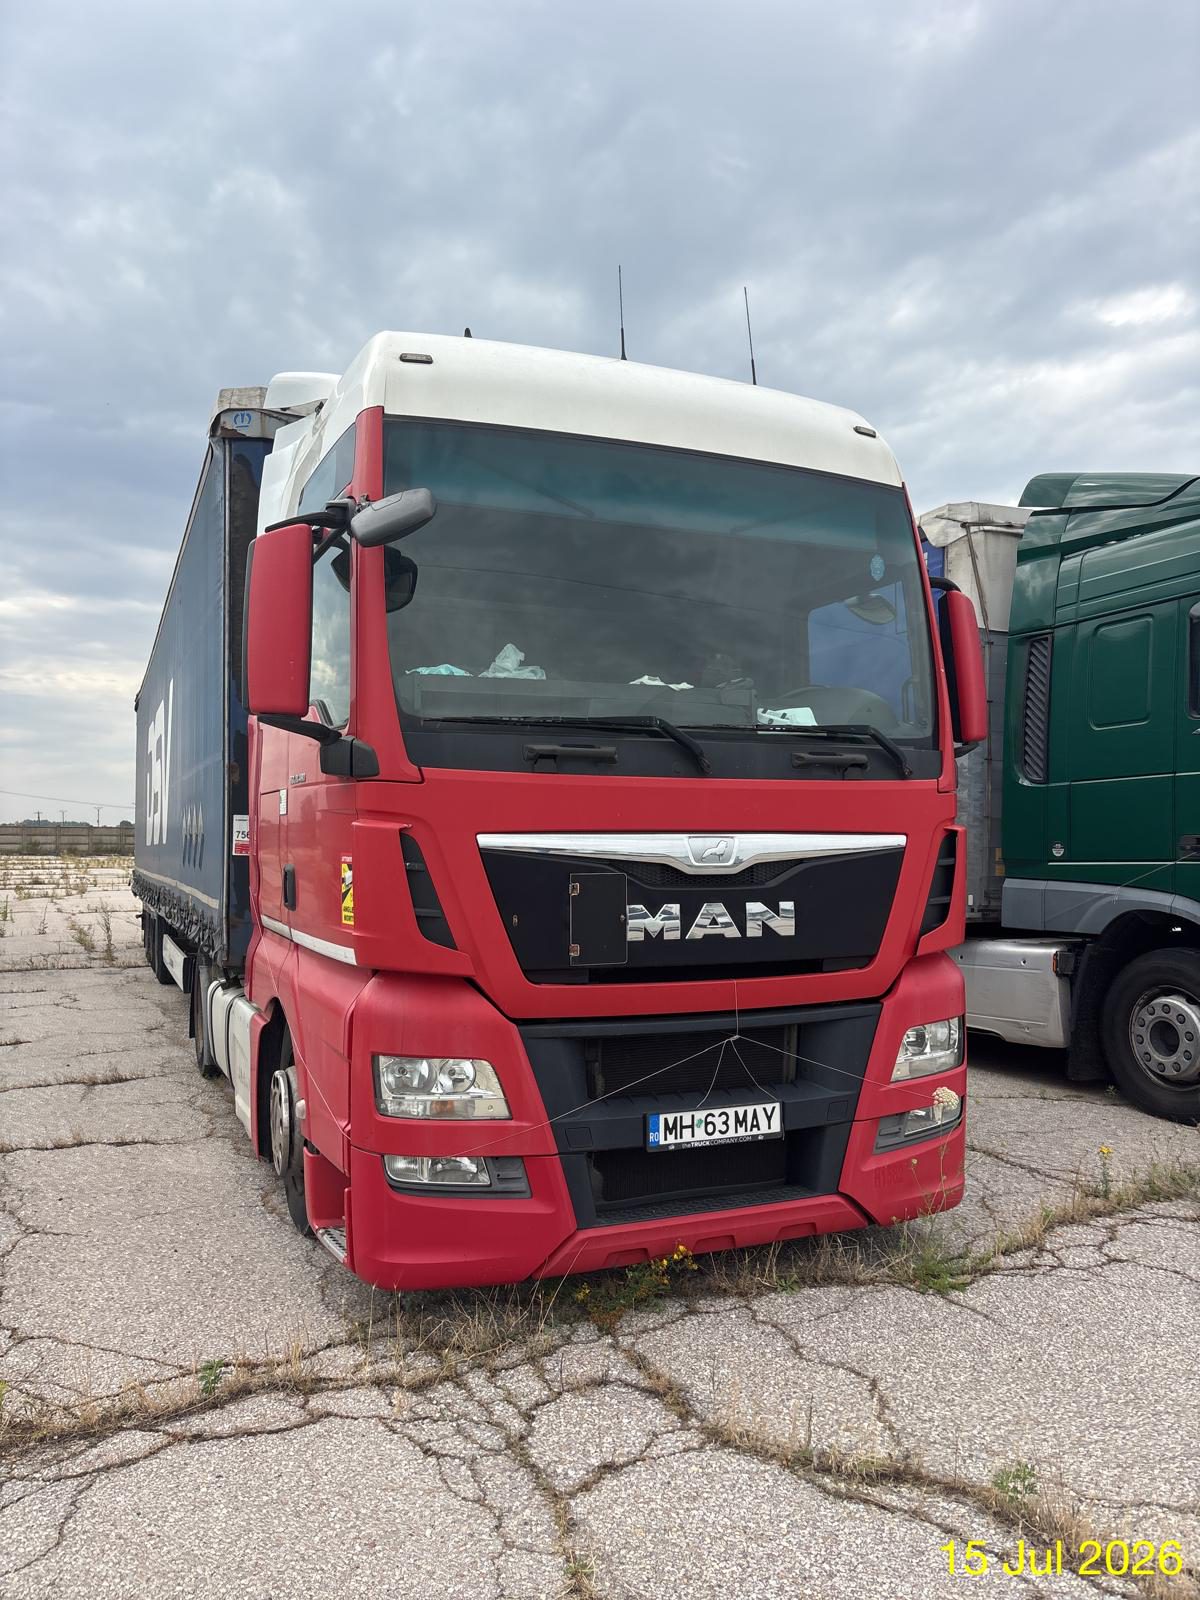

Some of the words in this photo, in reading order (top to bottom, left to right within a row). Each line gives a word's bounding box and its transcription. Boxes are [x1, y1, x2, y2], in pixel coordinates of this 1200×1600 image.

[626, 901, 795, 941] MAN
[649, 1132, 659, 1142] RO
[663, 1114, 695, 1141] MH
[704, 1111, 730, 1137] 63
[734, 1106, 776, 1133] MAY
